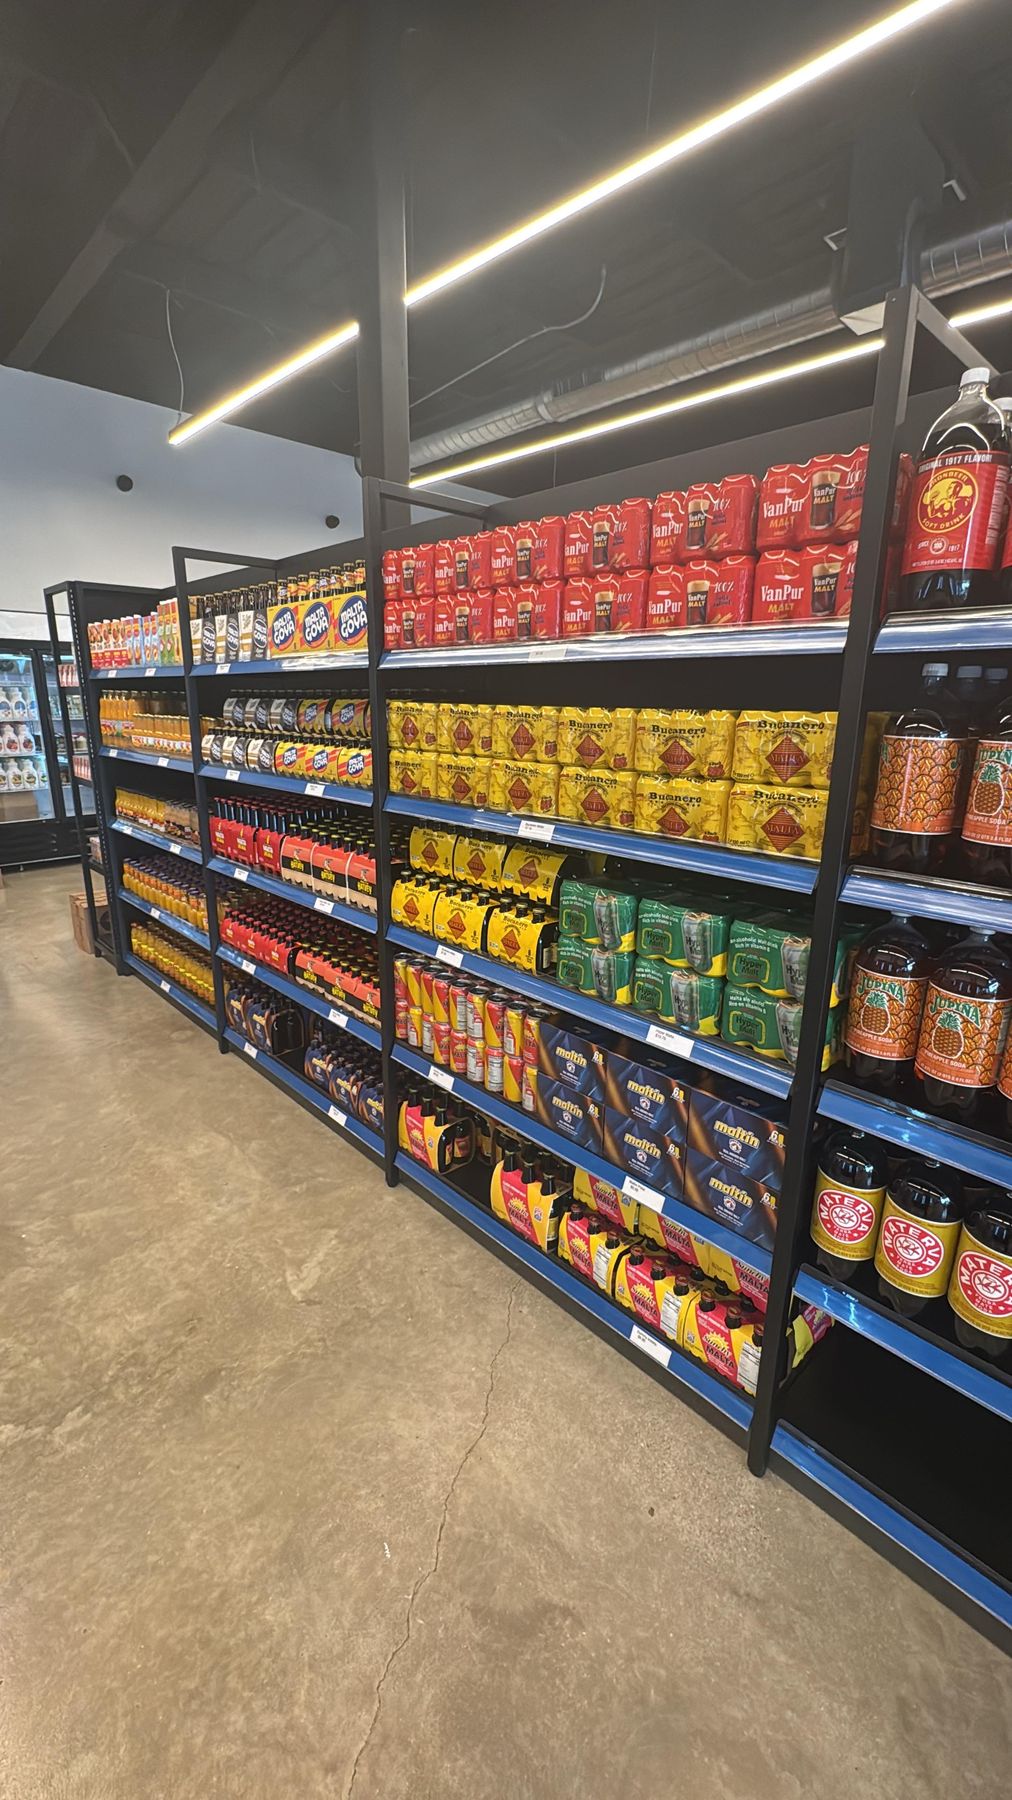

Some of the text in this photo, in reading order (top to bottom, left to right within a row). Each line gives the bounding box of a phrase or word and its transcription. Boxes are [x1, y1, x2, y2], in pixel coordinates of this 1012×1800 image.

[945, 457, 961, 466] 1917
[813, 487, 836, 497] VanPur
[813, 495, 835, 505] MALT
[763, 496, 805, 518] VanPur
[689, 520, 705, 529] MALT
[769, 516, 795, 528] MALT
[922, 514, 966, 529] SOFT DRINK
[656, 536, 677, 548] MALT
[814, 577, 837, 586] VanPur
[761, 584, 804, 601] VanPur
[814, 585, 835, 593] MALT
[340, 600, 363, 623] MALTA
[768, 602, 794, 613] MALT
[273, 611, 292, 631] MALTA
[304, 606, 325, 627] MALTA
[652, 615, 675, 625] MALT
[305, 616, 328, 641] GOYA
[341, 611, 368, 638] GOYA
[274, 620, 295, 644] GOYA
[651, 724, 706, 734] Bucanero
[757, 719, 825, 730] Bucanero
[348, 762, 364, 775] GOYA
[648, 792, 702, 803] Bucanero
[753, 790, 820, 803] Bucanero
[950, 1060, 966, 1069] SODA
[819, 1194, 872, 1232] MATERVA
[665, 1229, 691, 1248] MALTA
[885, 1221, 940, 1267] MATERVA
[740, 1272, 768, 1292] MALTA
[960, 1256, 1012, 1306] MATE
[706, 1345, 734, 1368] MALTA
